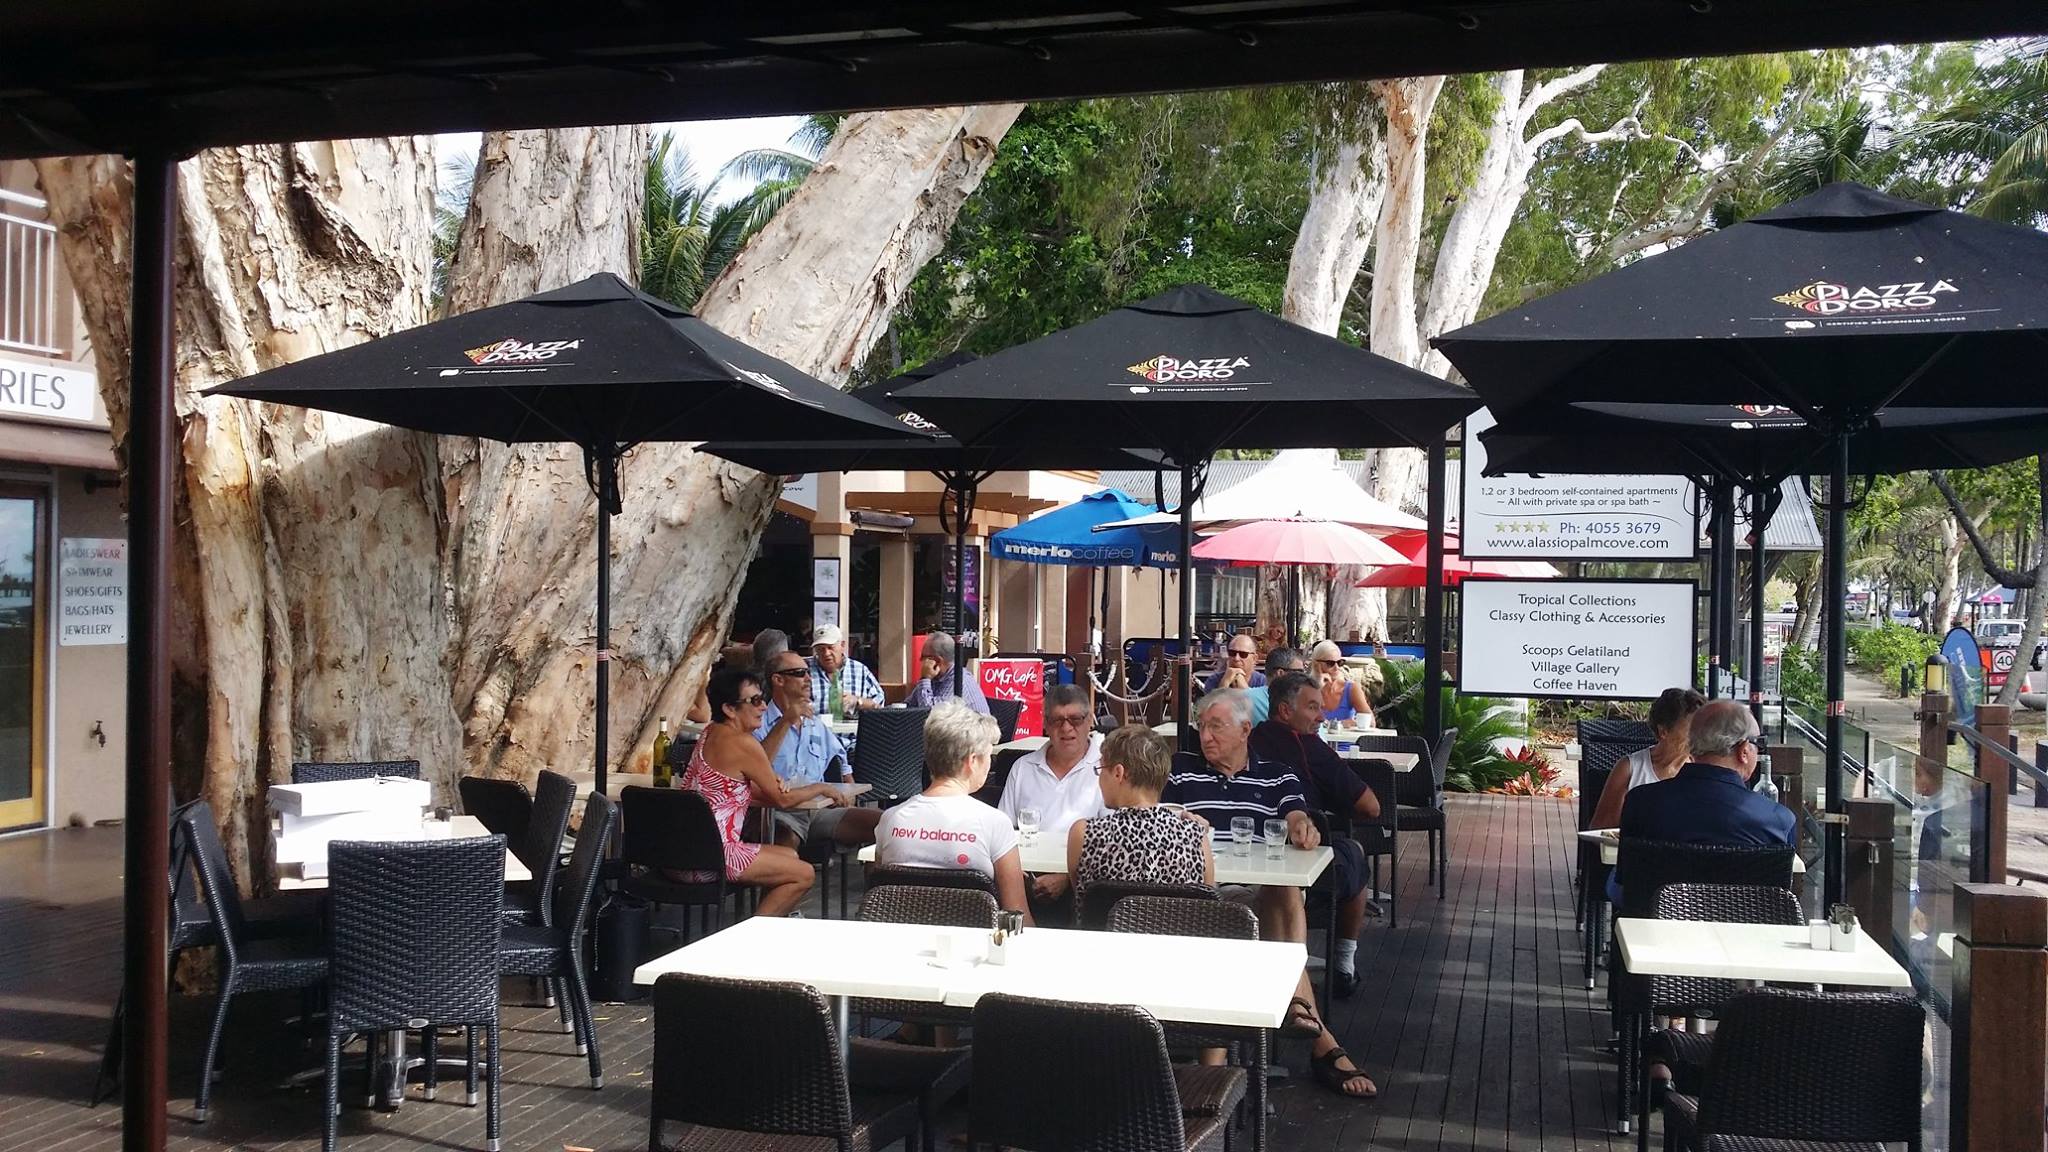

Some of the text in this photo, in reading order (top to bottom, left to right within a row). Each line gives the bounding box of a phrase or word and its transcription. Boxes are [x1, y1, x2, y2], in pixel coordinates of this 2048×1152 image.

[1817, 280, 1959, 300] PIAZZA
[495, 338, 579, 352] PIAZZA
[1158, 355, 1250, 370] PIAZZA
[0, 368, 66, 410] RIES
[1509, 487, 1515, 495] 3
[1518, 487, 1559, 495] bedroom
[1562, 487, 1624, 495] self-contained
[1626, 488, 1678, 498] apartments
[1507, 498, 1520, 506] All
[1523, 498, 1543, 506] with
[1545, 498, 1578, 508] private
[1579, 499, 1595, 508] spa
[1611, 500, 1626, 508] spa
[1629, 498, 1649, 506] bath
[1560, 522, 1661, 534] Ph: 4055 3679
[1487, 536, 1669, 551] www.alassiopalmcove.com
[65, 547, 121, 559] LADIESWEAR
[66, 567, 113, 577] SWIMWEAR
[1518, 593, 1636, 607] Tropical Collections
[1489, 609, 1666, 625] Classy Clothing & Accessories
[65, 623, 113, 635] JEWELLERY
[1522, 644, 1630, 657] Scoops Gelatiland
[1997, 655, 2013, 667] 40
[1531, 661, 1620, 676] Village Gallery
[1533, 678, 1617, 691] Coffee Haven
[892, 827, 977, 843] new balance
